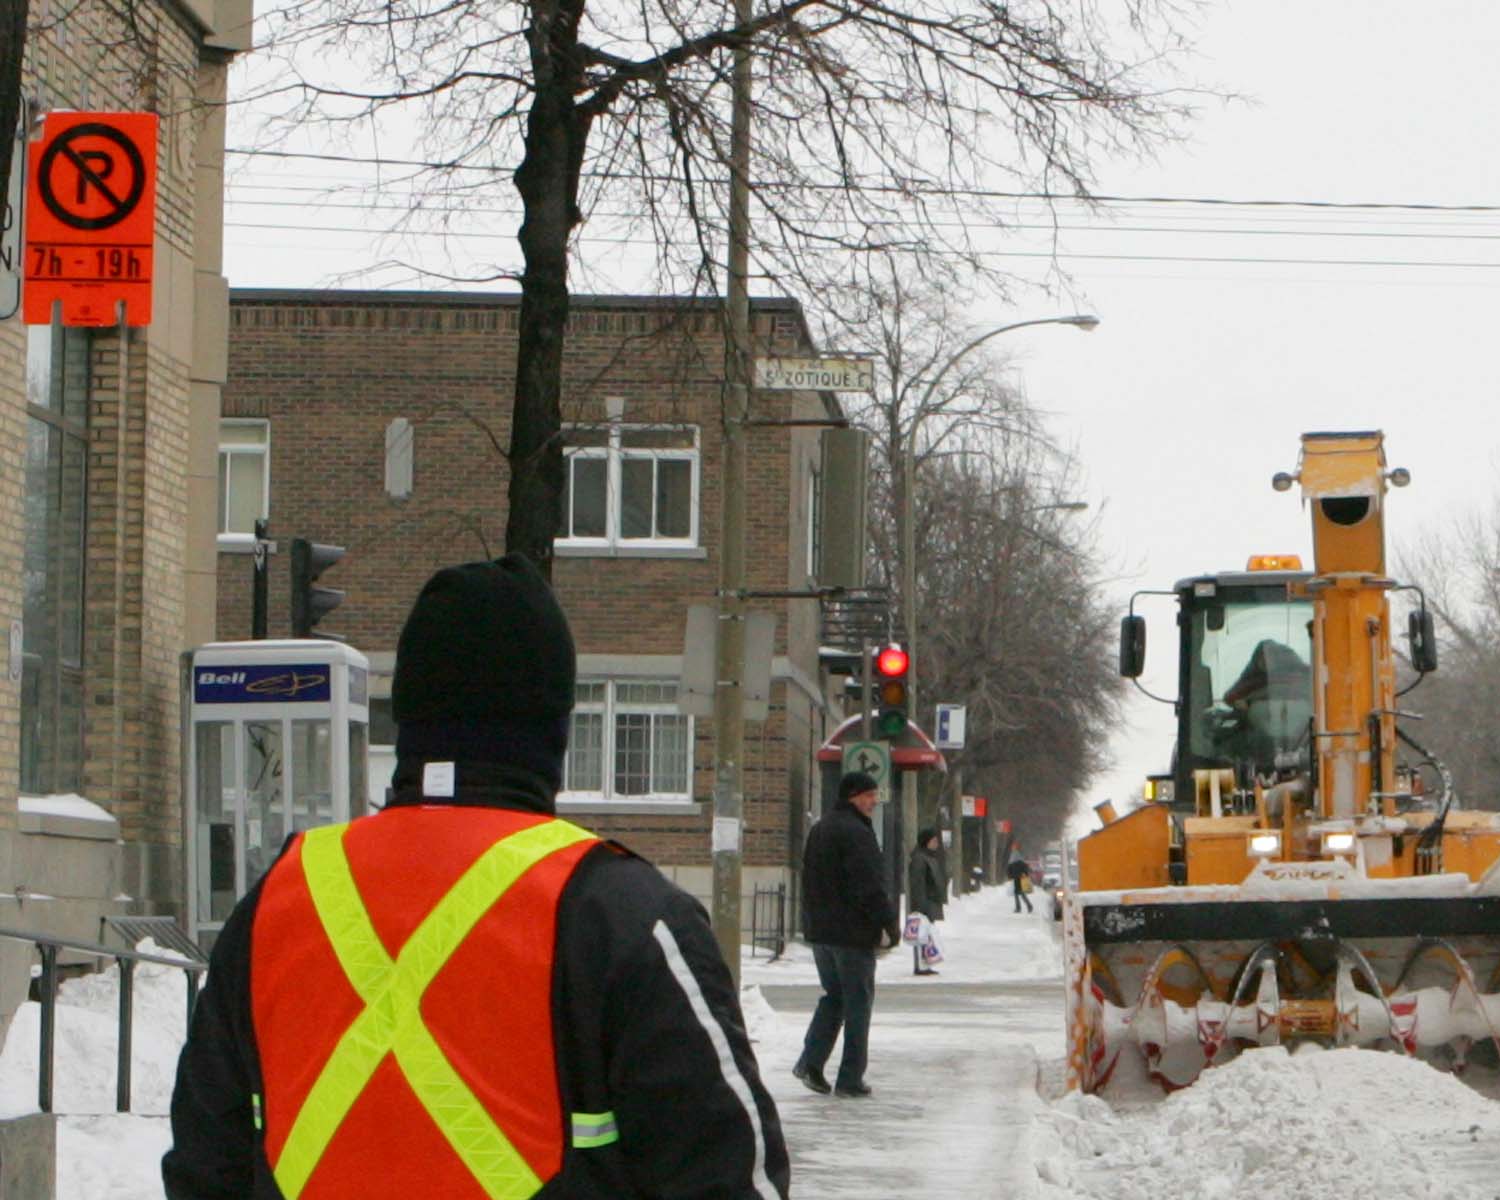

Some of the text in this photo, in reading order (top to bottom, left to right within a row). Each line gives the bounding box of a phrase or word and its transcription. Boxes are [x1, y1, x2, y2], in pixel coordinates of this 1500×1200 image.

[33, 247, 62, 276] 7h
[96, 248, 141, 278] 19h
[785, 371, 851, 387] ZOTIQUE
[198, 672, 247, 685] Bell
